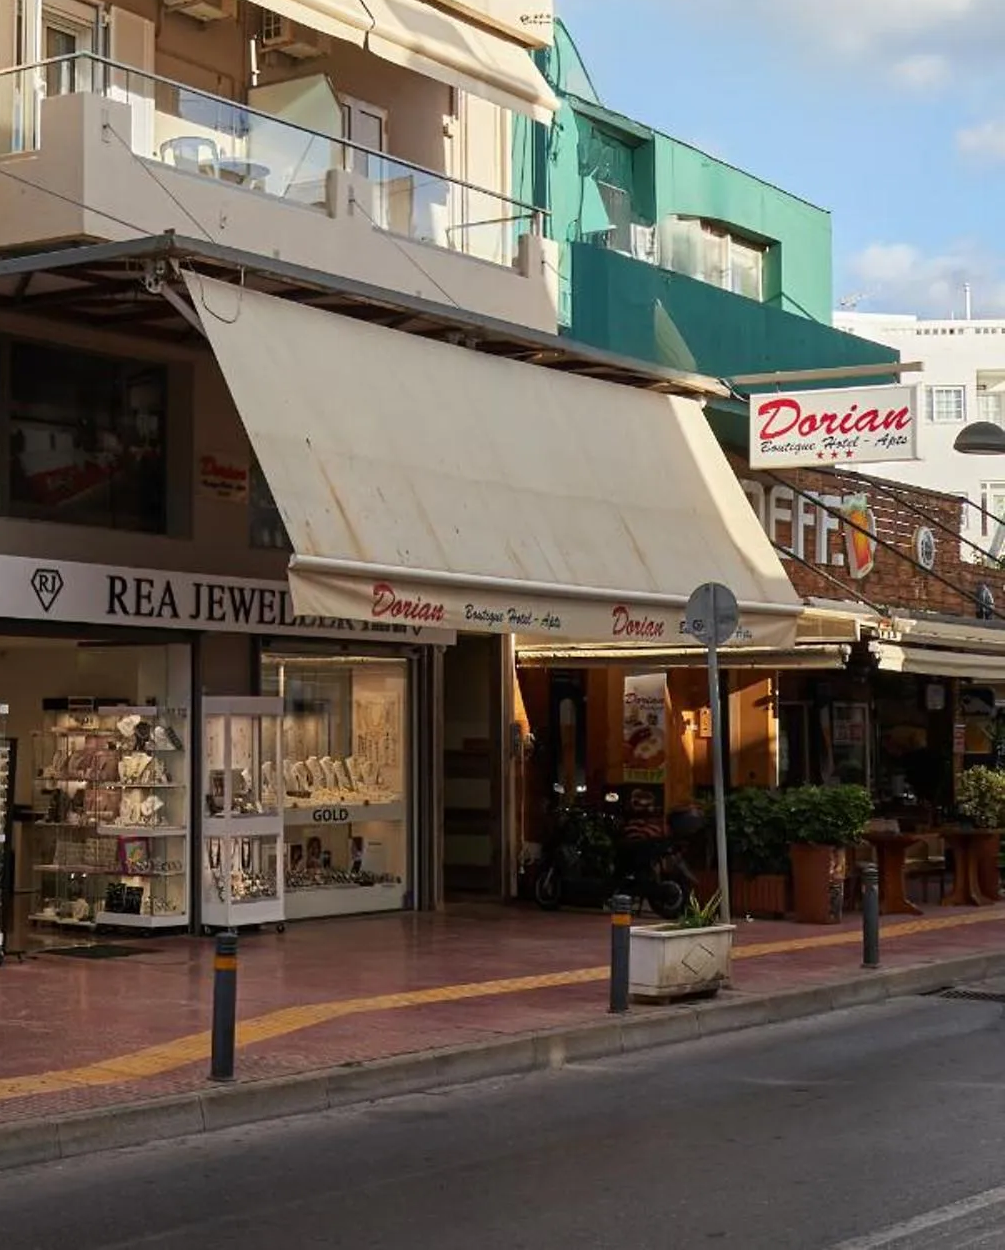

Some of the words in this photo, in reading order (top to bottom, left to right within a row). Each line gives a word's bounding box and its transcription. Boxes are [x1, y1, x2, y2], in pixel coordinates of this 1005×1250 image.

[758, 398, 912, 440] Dorian
[761, 440, 815, 454] Boutique
[822, 436, 859, 449] Hotel
[875, 433, 908, 449] Apts
[39, 574, 57, 593] RJ
[107, 575, 181, 619] REA
[371, 581, 445, 622] Dorian
[612, 605, 664, 637] Dorian
[313, 808, 349, 822] GOLD
